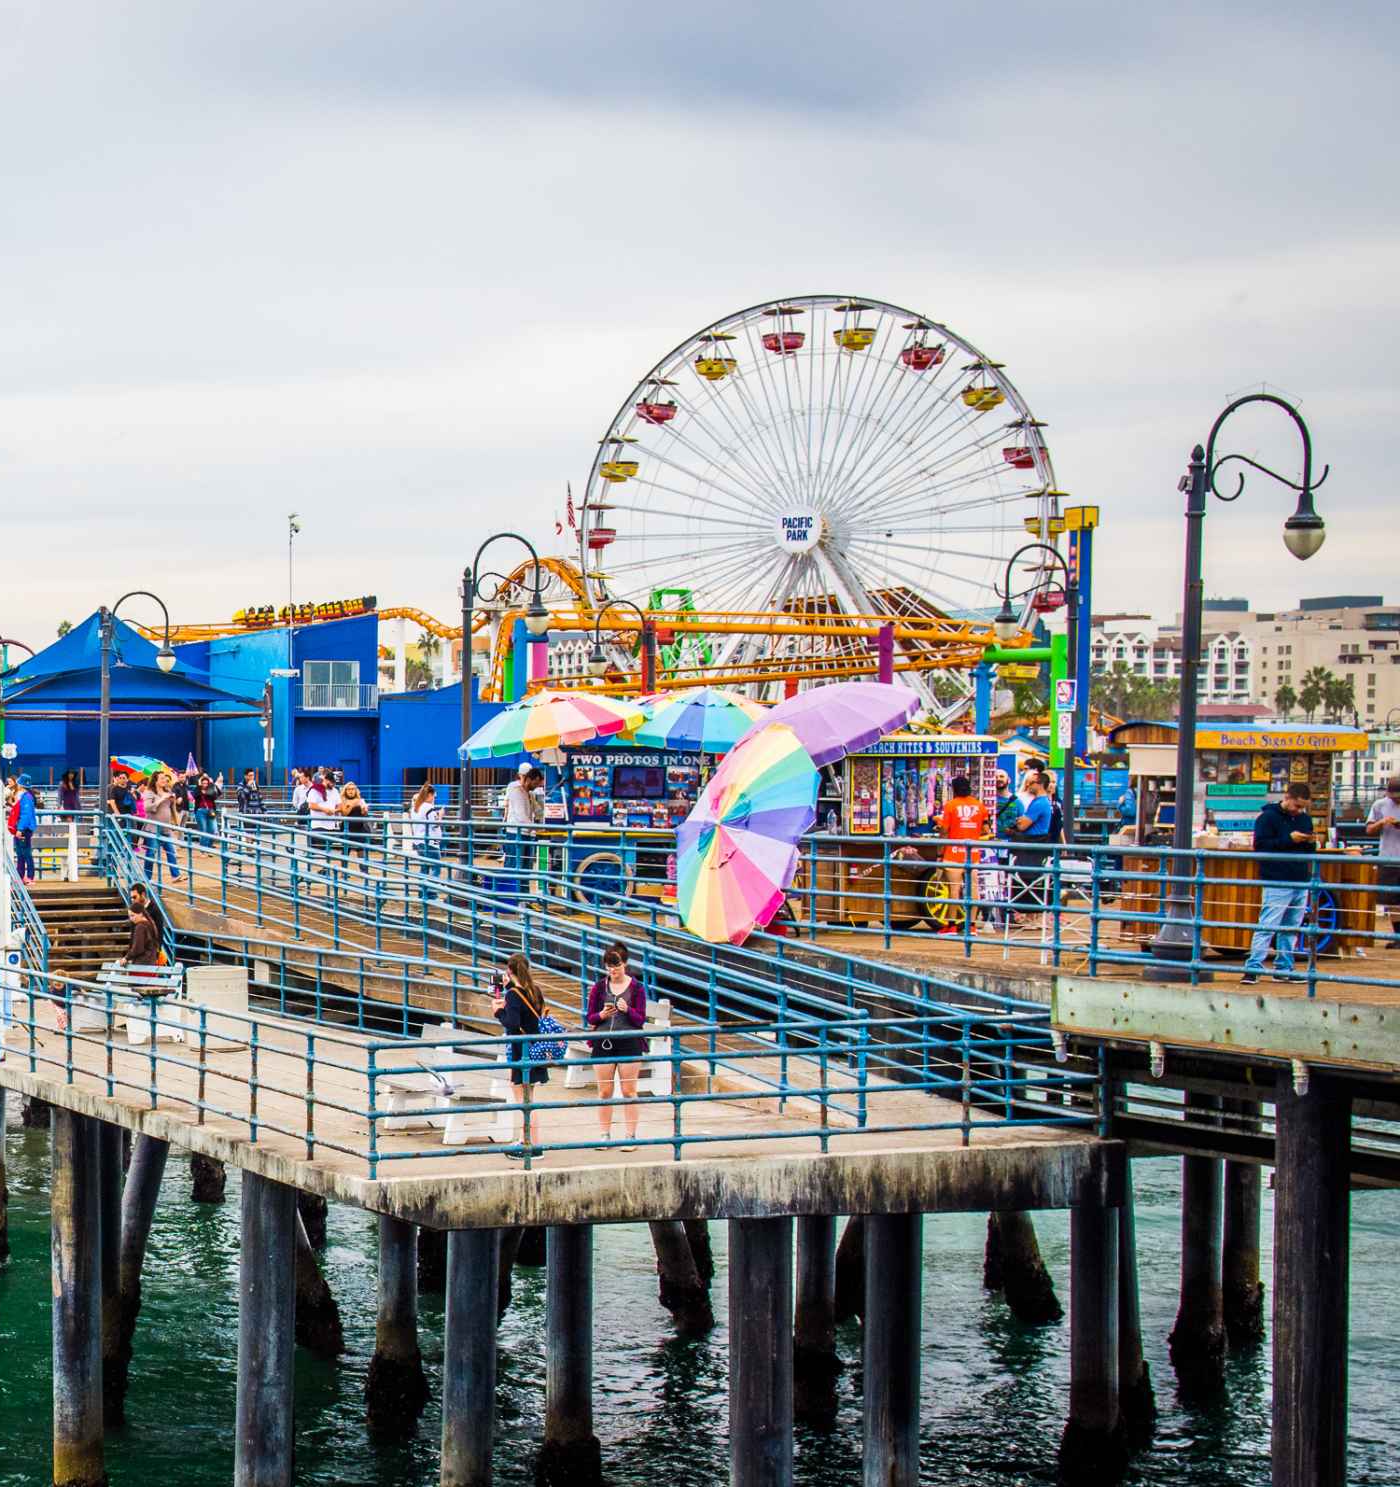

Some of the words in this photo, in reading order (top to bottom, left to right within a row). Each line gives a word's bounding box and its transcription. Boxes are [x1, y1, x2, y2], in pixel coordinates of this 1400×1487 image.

[782, 517, 813, 528] PACIFIC
[786, 530, 808, 540] PARK
[1221, 734, 1255, 745] Beach
[1260, 734, 1293, 748] Signs
[898, 742, 923, 753] KITES
[926, 742, 933, 753] &
[936, 742, 982, 753] SOUVENIRS
[571, 755, 602, 765] TWO
[606, 755, 659, 766] PHOTOS
[663, 755, 677, 765] IN
[682, 755, 710, 765] ONE
